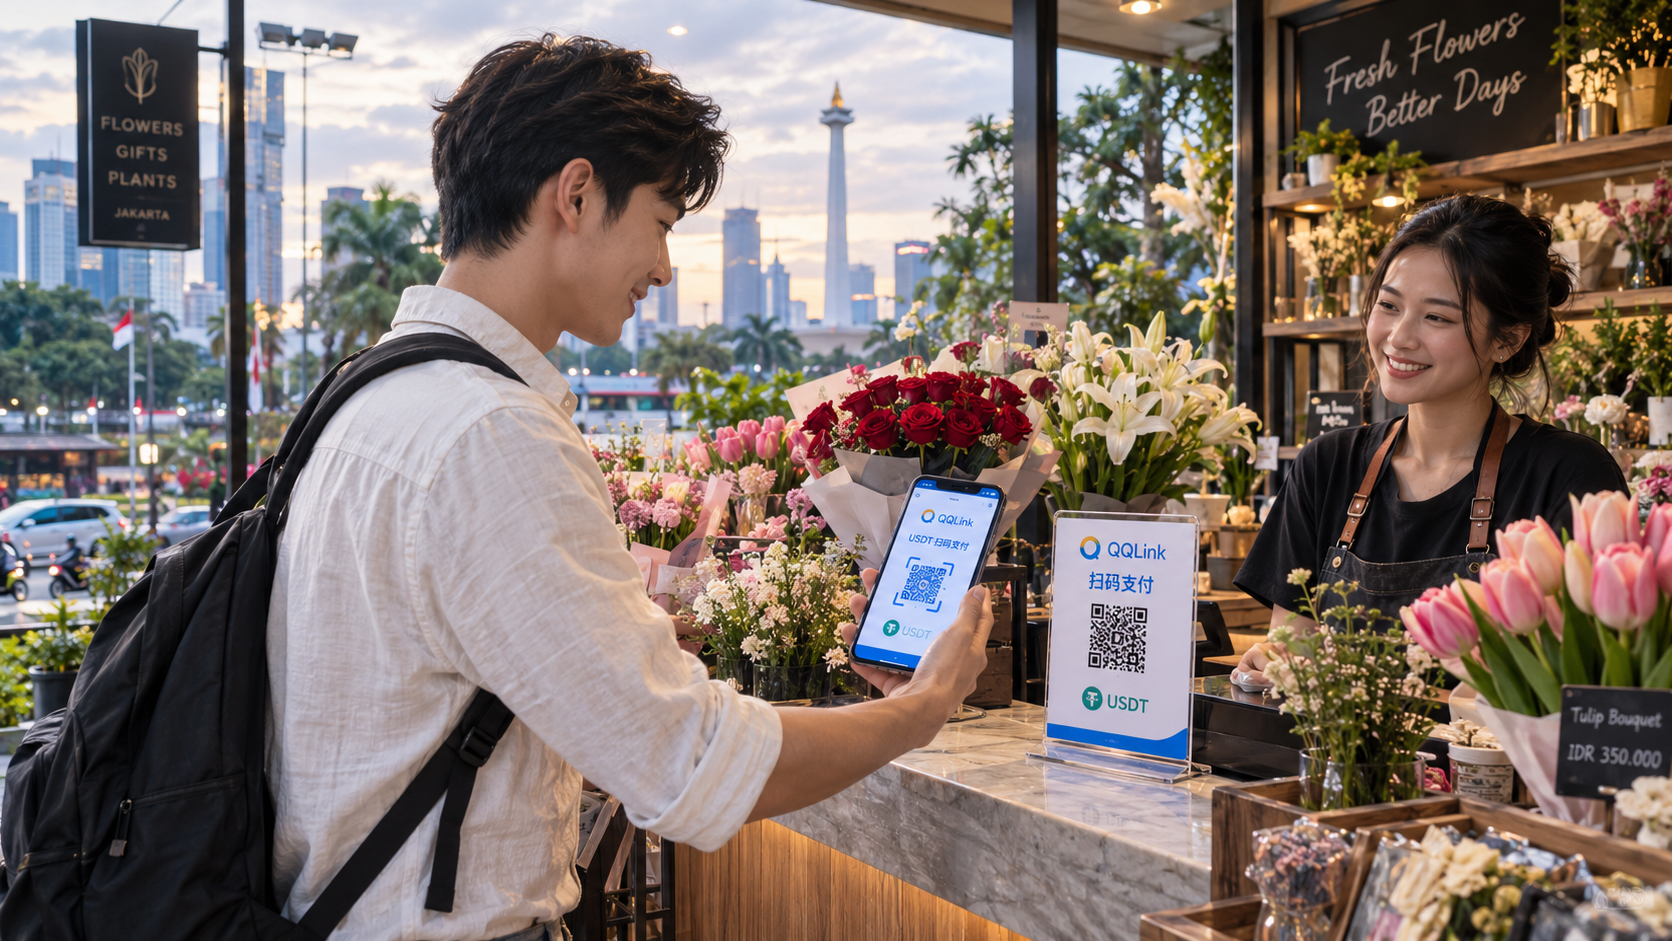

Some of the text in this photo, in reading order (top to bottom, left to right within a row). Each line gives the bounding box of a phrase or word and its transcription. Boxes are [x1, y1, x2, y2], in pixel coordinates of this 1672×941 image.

[1324, 12, 1526, 106] Fresh Flowers
[1365, 68, 1527, 138] Better Days
[101, 115, 184, 137] FLOWERS
[115, 144, 168, 162] GIFTS
[108, 170, 177, 189] PLANTS
[114, 207, 170, 221] JAKARTA
[937, 513, 974, 527] QQLink
[908, 533, 970, 552] USDT 扫码支付
[1107, 541, 1166, 560] QQLink
[1088, 571, 1154, 594] 扫码支付
[901, 625, 933, 640] USDT
[1107, 694, 1149, 713] USDT
[1570, 706, 1663, 733] Tulip Bouquet
[1567, 743, 1662, 769] IDR 350.000
